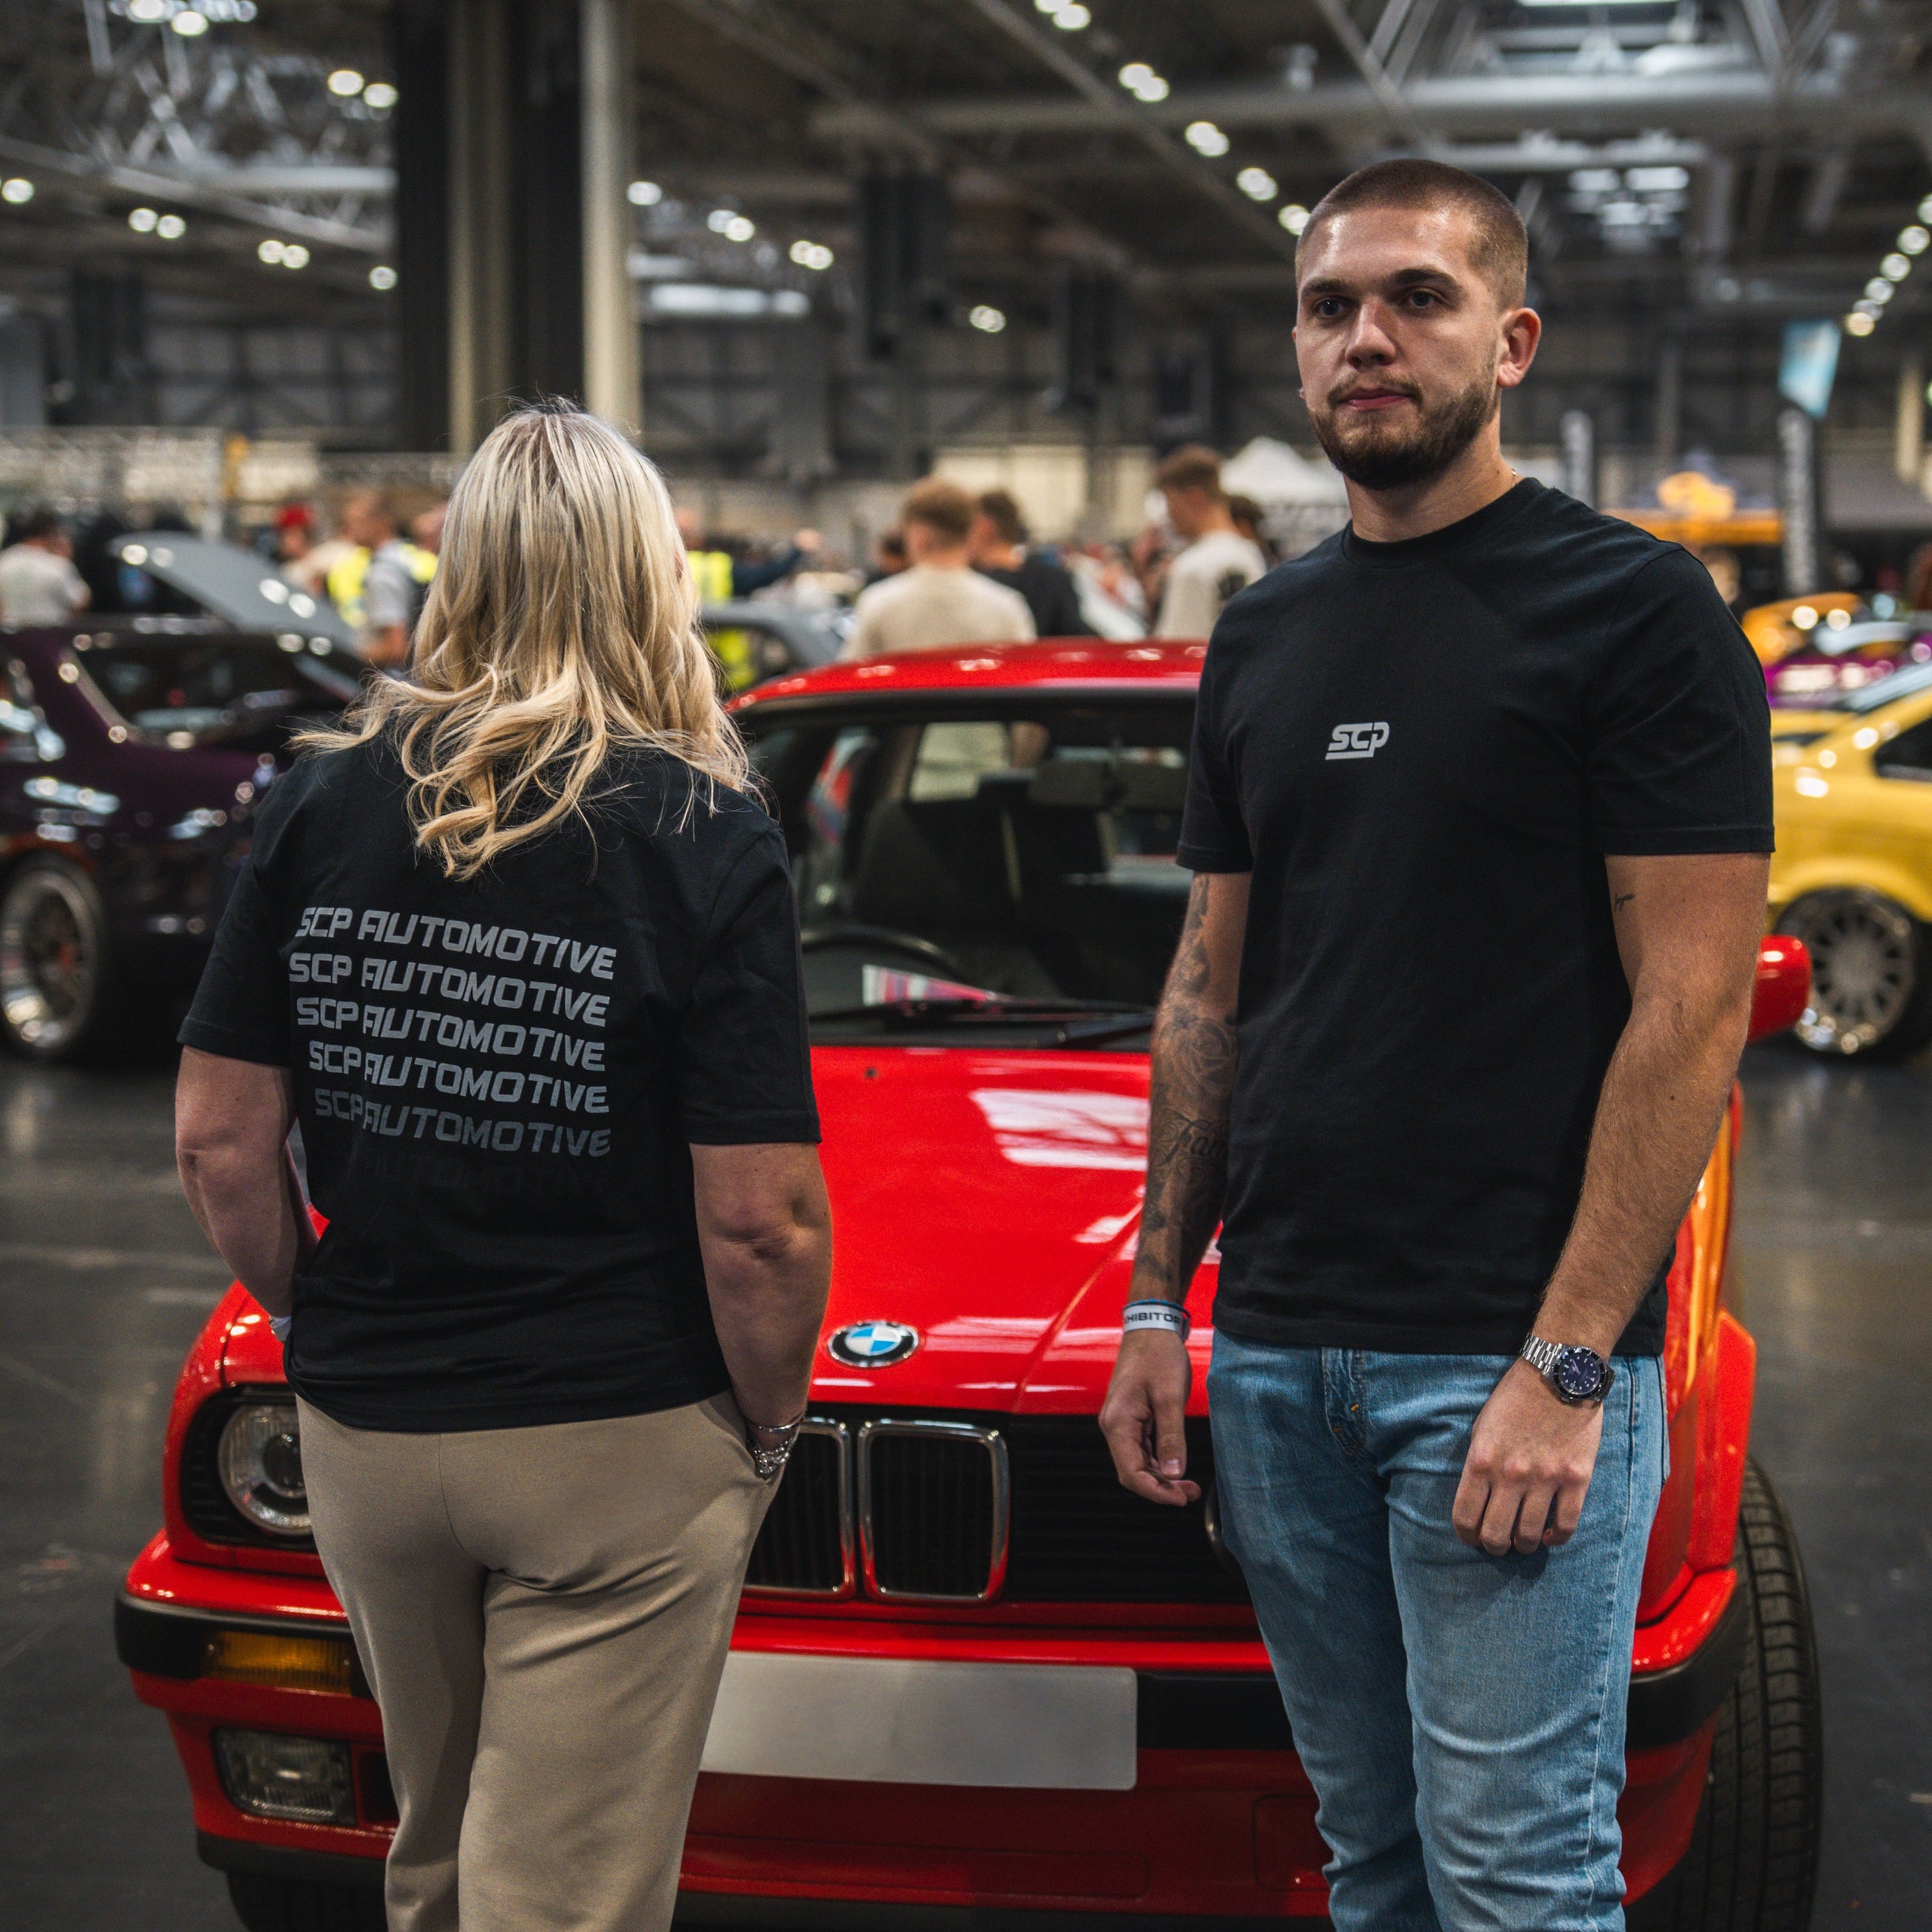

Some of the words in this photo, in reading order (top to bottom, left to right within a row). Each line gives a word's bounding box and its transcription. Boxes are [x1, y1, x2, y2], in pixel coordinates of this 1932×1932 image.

[1325, 721, 1391, 761] SCP
[294, 906, 353, 939] SCP
[357, 909, 617, 980] AUTOMOTIVE
[288, 952, 352, 985] SCP
[361, 957, 611, 1028] AUTOMOTIVE
[296, 996, 359, 1030] SCP
[363, 1004, 606, 1072] AUTOMOTIVE
[308, 1040, 362, 1075] SCP
[364, 1051, 610, 1114] AUTOMOTIVE
[314, 1088, 363, 1121] SCP
[362, 1100, 611, 1157] AUTOMOTIVE
